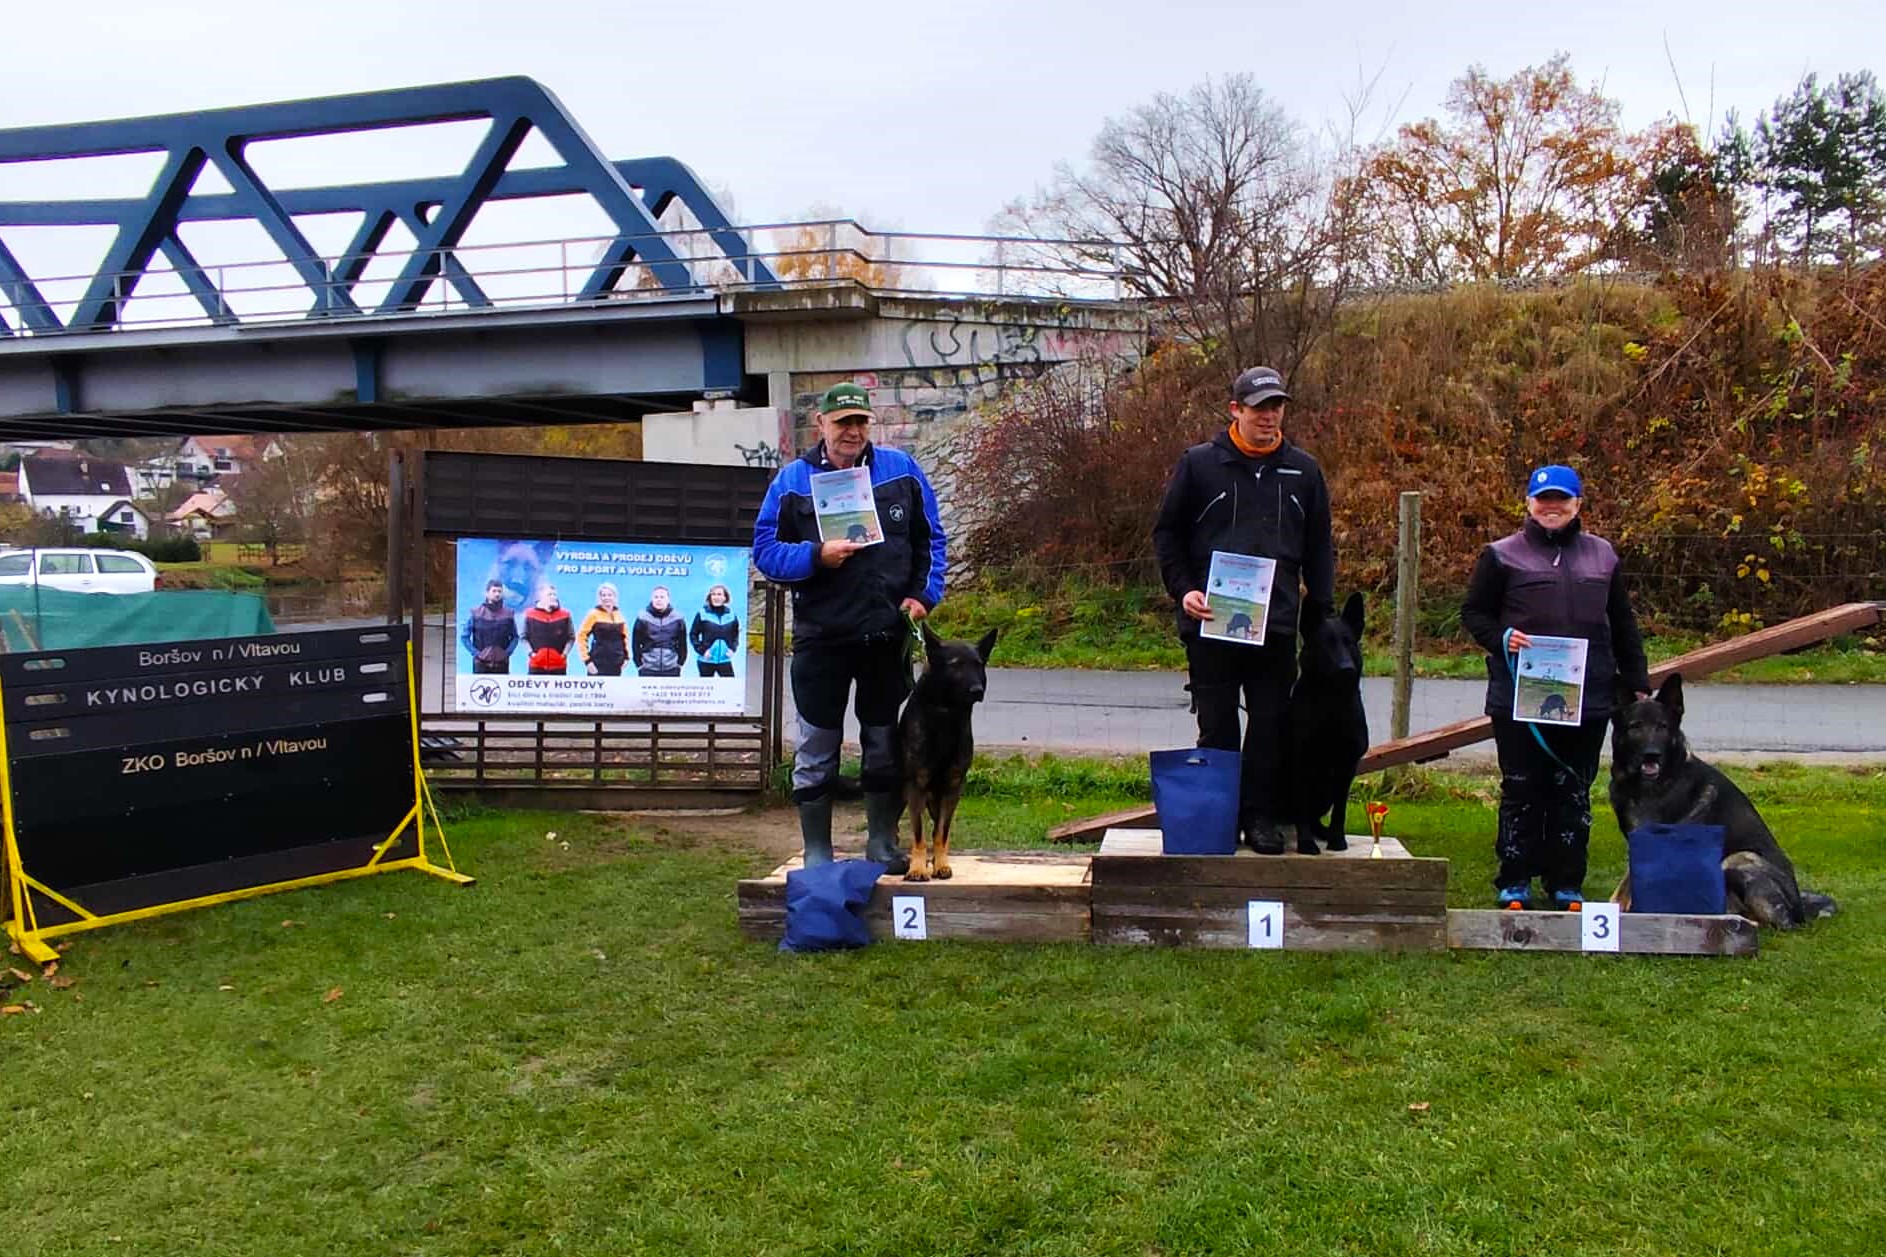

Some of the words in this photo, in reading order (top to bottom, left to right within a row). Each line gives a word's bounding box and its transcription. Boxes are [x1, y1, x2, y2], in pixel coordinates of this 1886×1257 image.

[602, 552, 610, 561] A
[613, 552, 654, 562] PRODEJ
[557, 564, 580, 574] PRO
[581, 564, 616, 575] SPORT
[618, 565, 626, 575] A
[139, 648, 201, 666] Boršov
[212, 648, 223, 660] n
[238, 642, 301, 658] Vltavou
[289, 668, 346, 687] KLUB
[122, 754, 165, 774] ZKO
[175, 747, 236, 768] Boršov
[241, 746, 252, 759] n
[266, 736, 327, 755] Vltavou
[902, 906, 919, 929] 2
[1260, 913, 1271, 937] 1
[1592, 914, 1610, 939] 3
